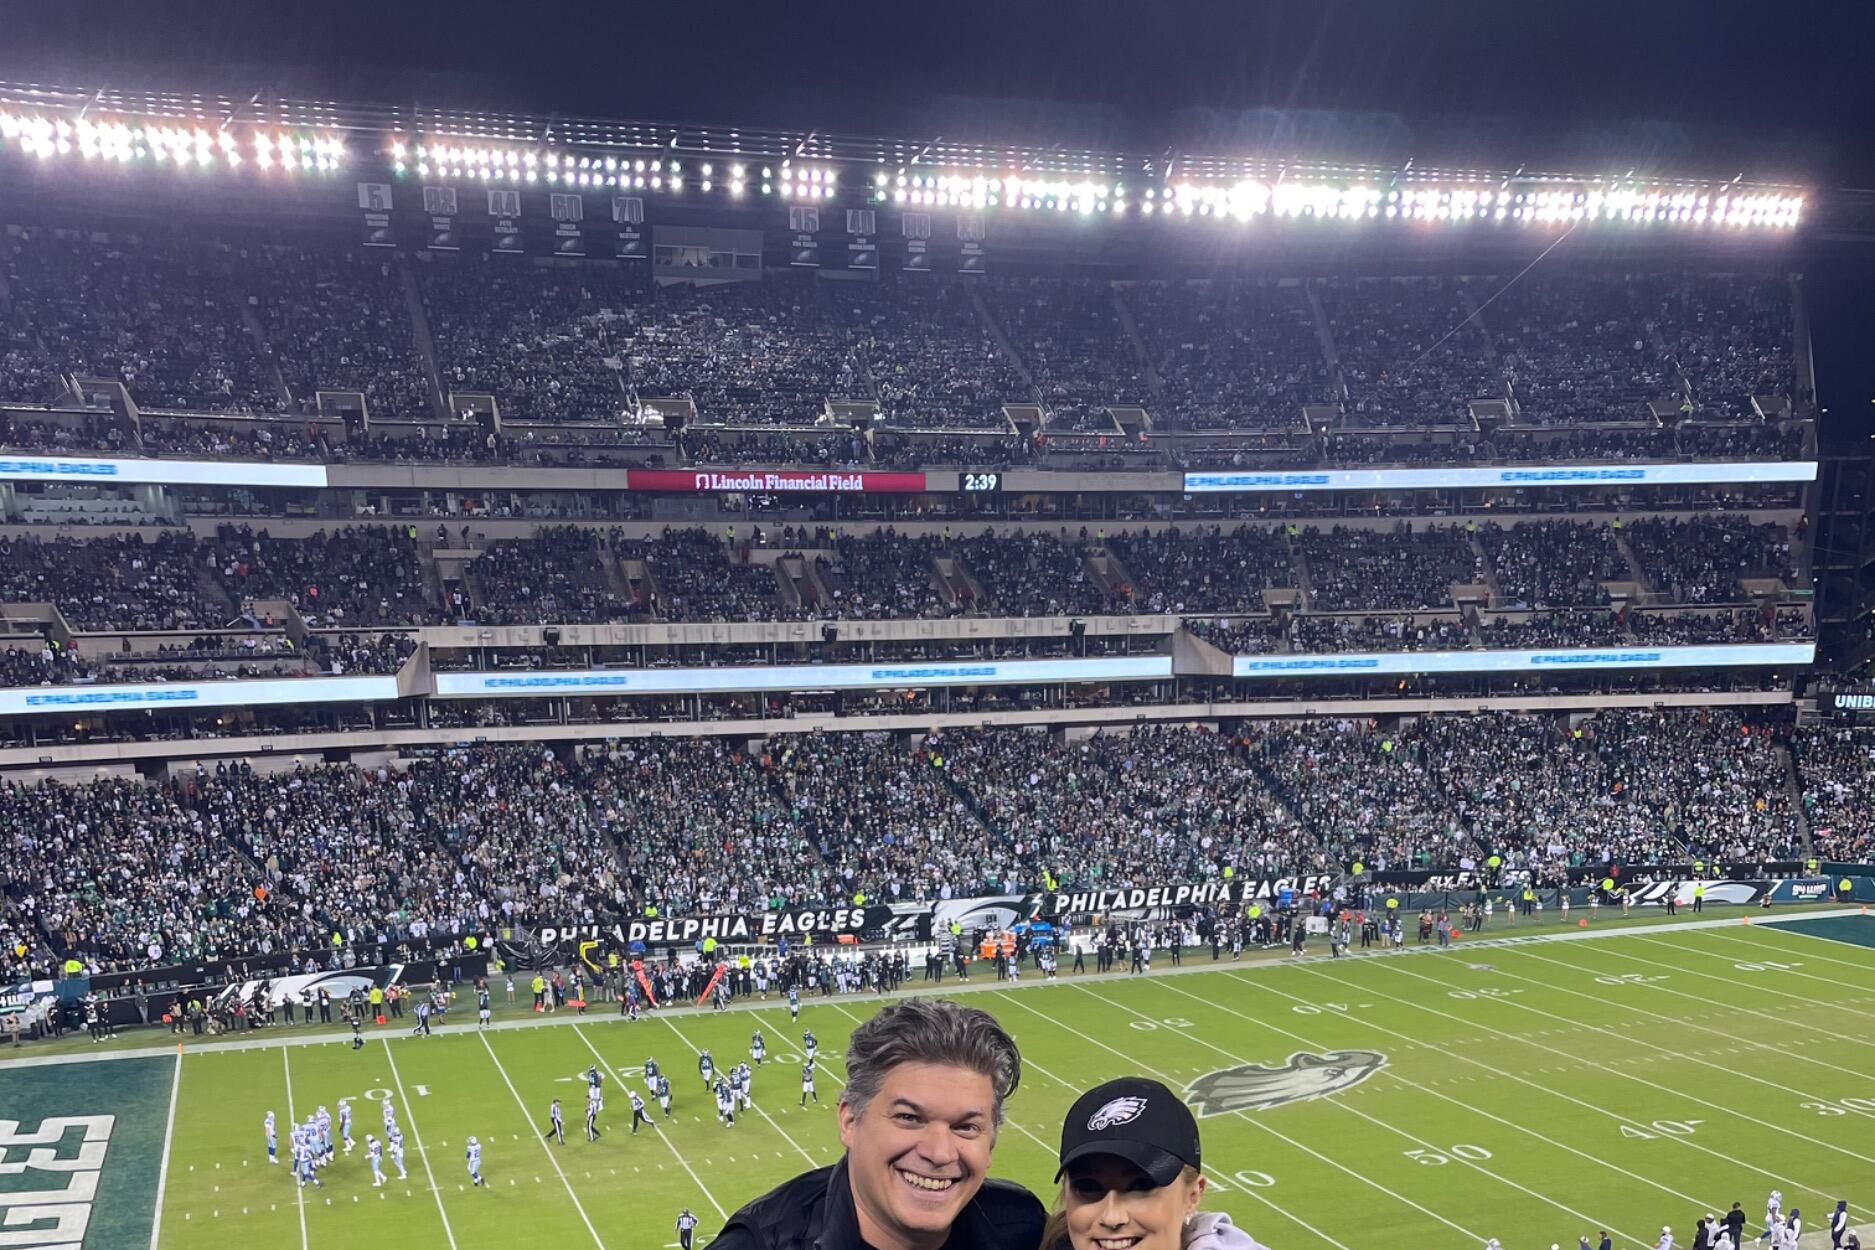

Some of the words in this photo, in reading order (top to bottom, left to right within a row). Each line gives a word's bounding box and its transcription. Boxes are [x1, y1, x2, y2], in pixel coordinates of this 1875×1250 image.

[491, 191, 518, 218] 44
[615, 197, 641, 224] 70
[711, 474, 764, 490] Lincoln
[764, 474, 828, 491] Financial
[828, 475, 863, 491] Field
[964, 474, 997, 490] 2:39
[1834, 694, 1875, 708] UNIB
[1054, 883, 1231, 914] PHILADELPHIA
[761, 907, 866, 935] EAGLES
[1620, 1119, 1697, 1140] 40
[1403, 1143, 1493, 1166] 50
